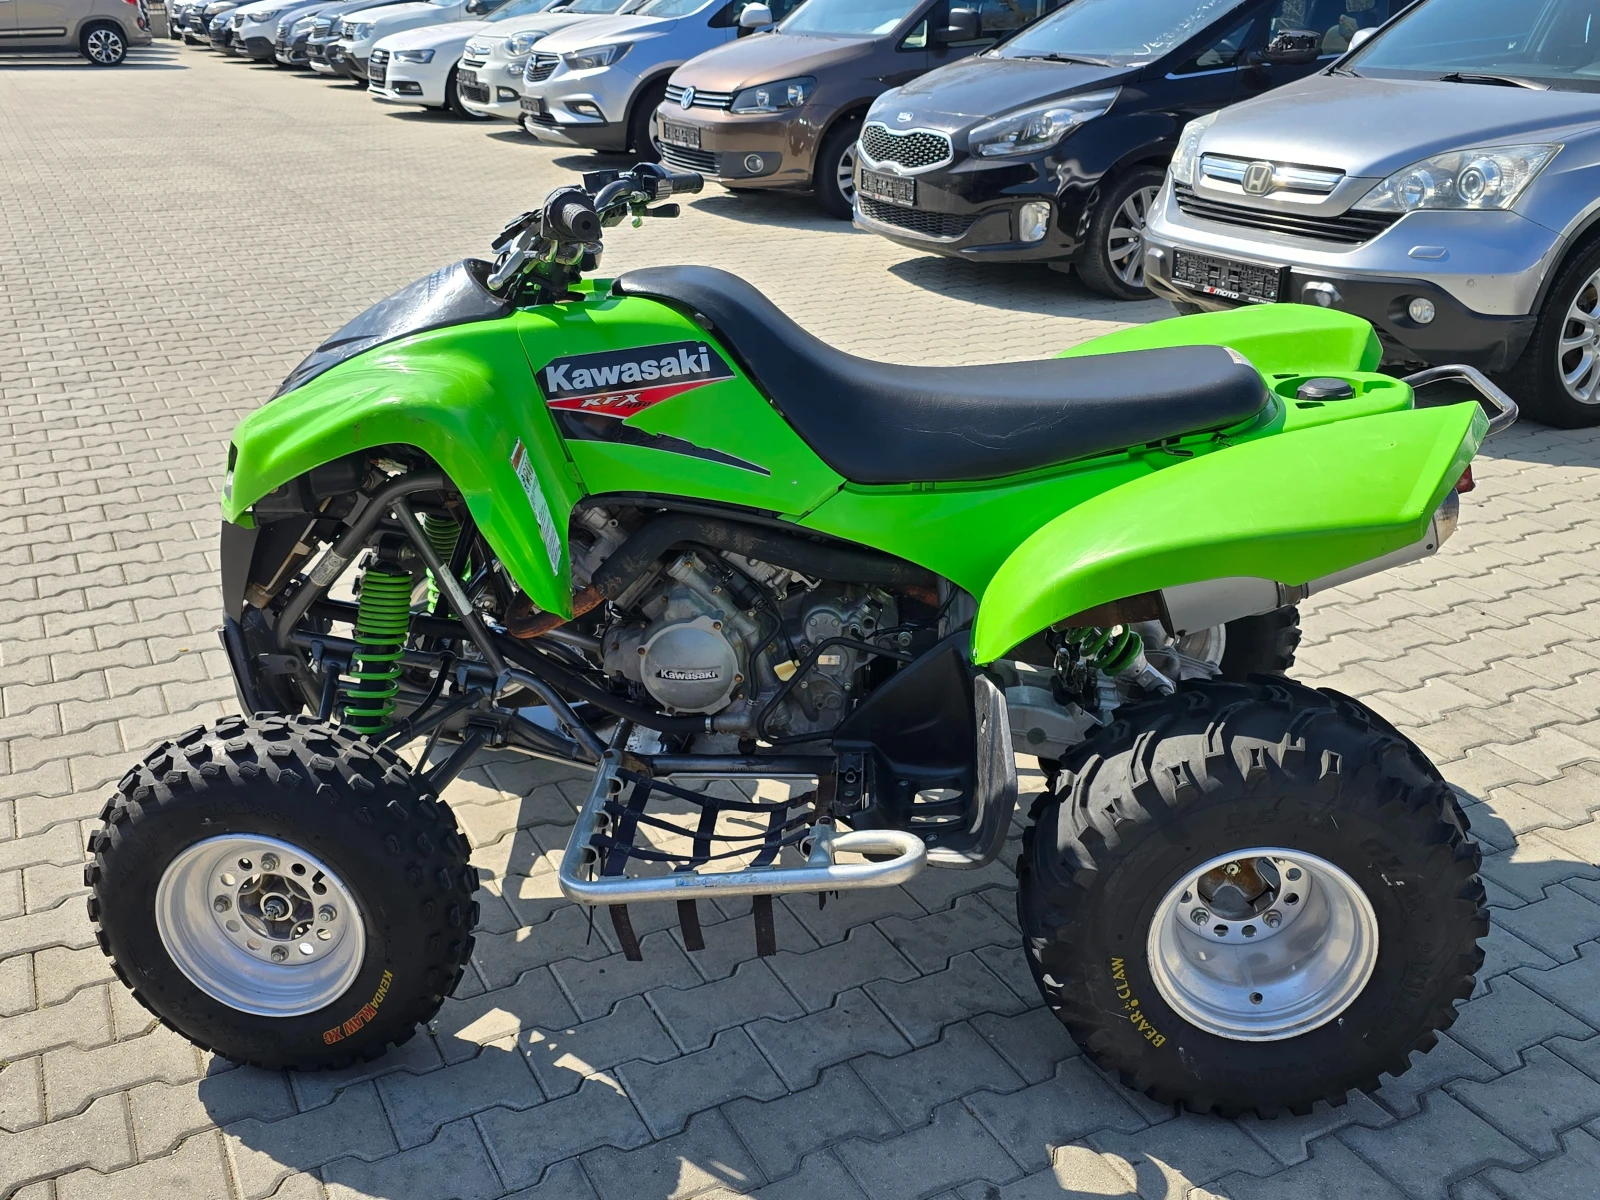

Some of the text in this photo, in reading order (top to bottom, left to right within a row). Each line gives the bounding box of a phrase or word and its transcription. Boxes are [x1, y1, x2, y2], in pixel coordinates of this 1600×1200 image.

[545, 346, 711, 393] Kawasaki
[580, 392, 642, 408] KFX
[660, 668, 717, 680] Kawasaki
[322, 969, 393, 1045] KENDA KLAW XC
[1111, 957, 1166, 1048] BEAR CLAW
